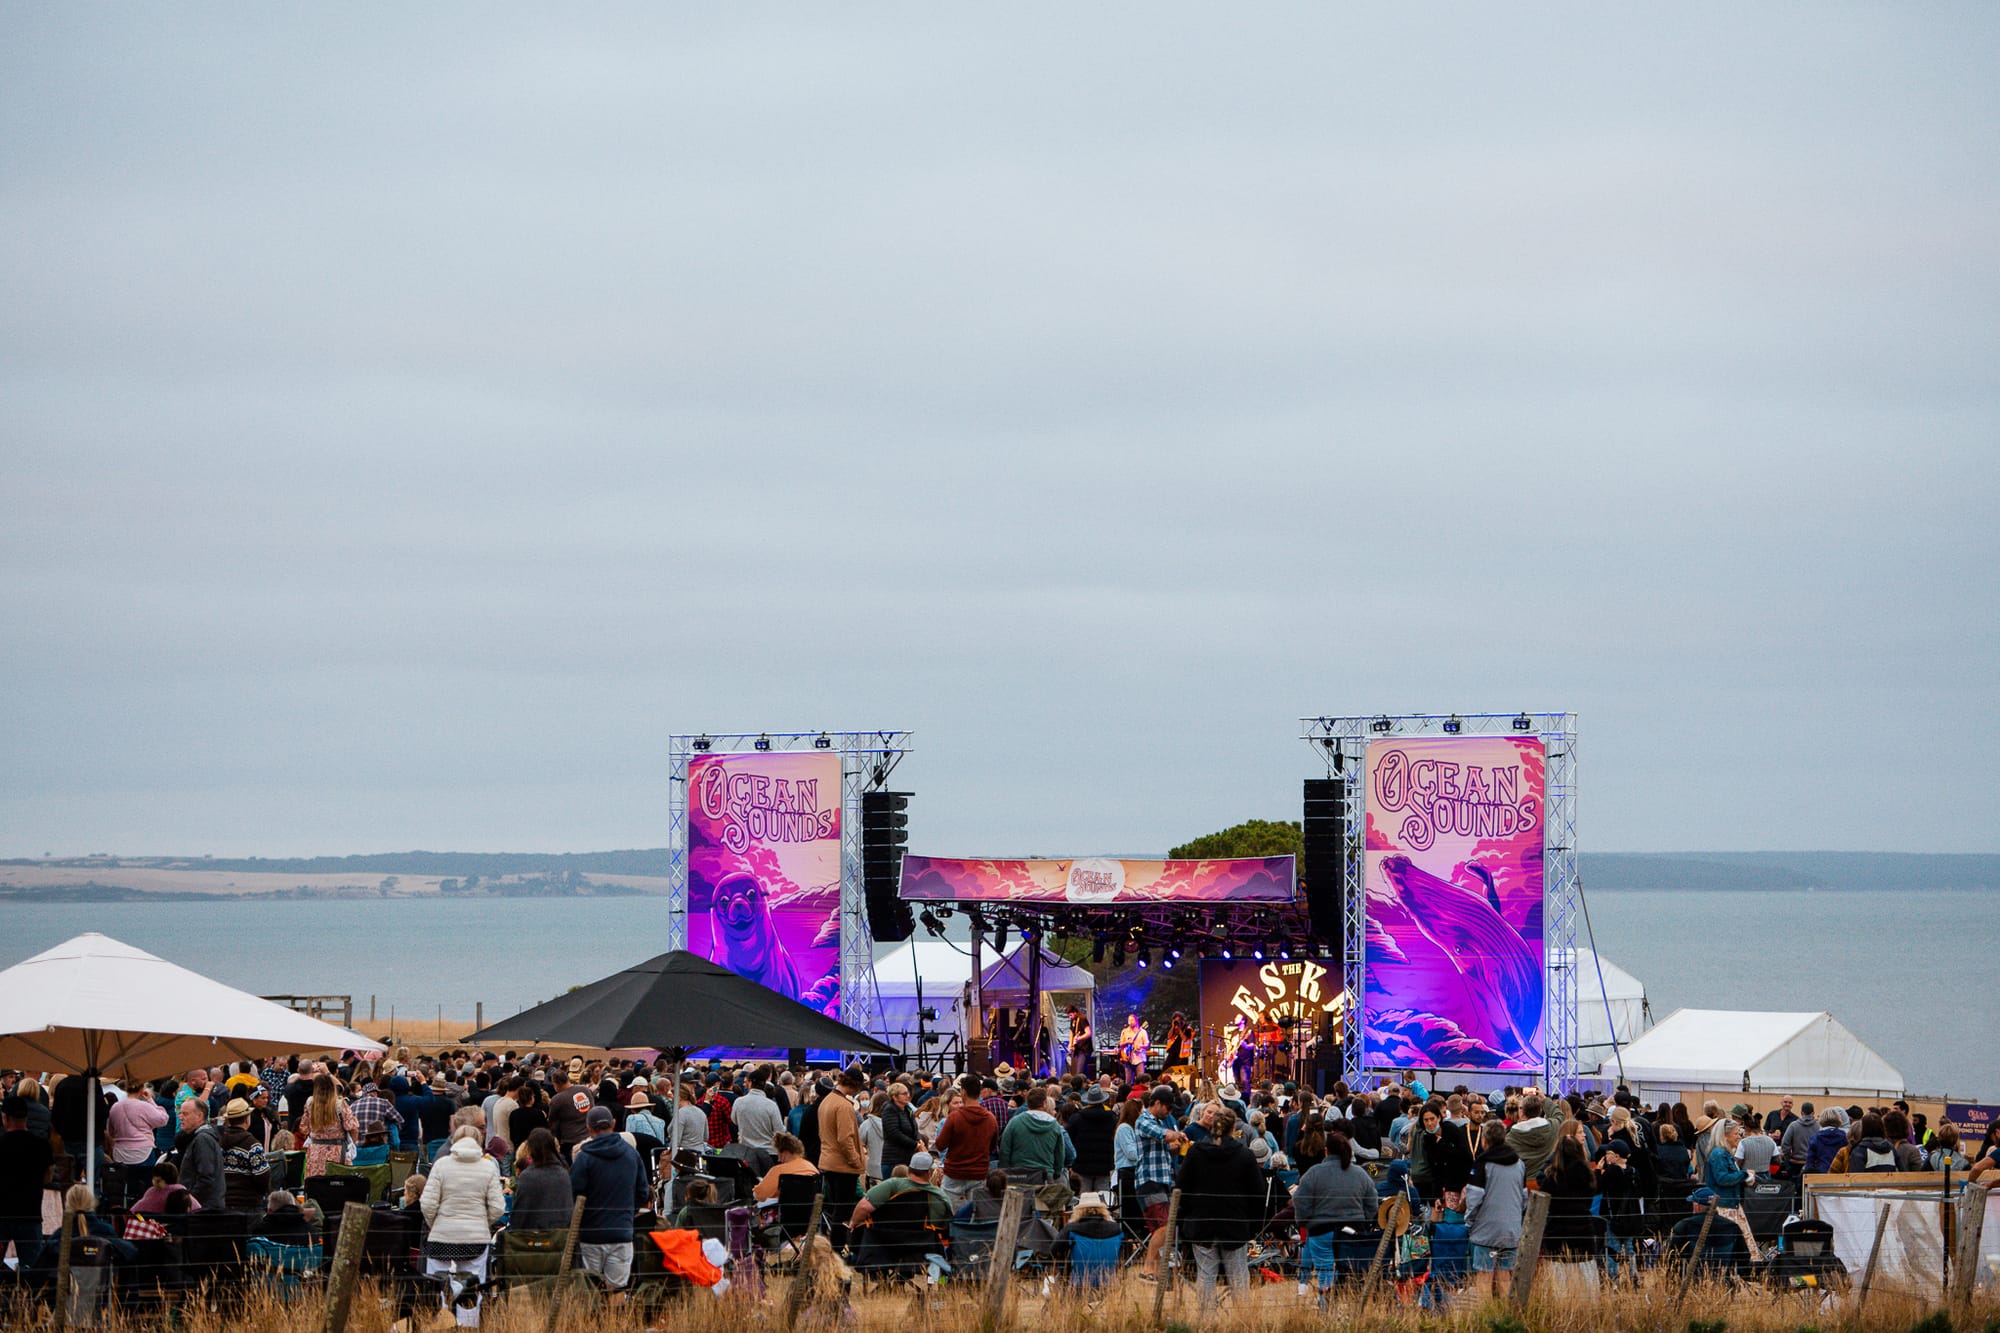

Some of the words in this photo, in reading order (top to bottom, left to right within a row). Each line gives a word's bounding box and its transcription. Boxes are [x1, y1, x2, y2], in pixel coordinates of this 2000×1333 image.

[699, 765, 817, 820] OCEAN
[1373, 750, 1519, 812] OCEAN
[720, 799, 832, 855] SOUNDS
[1398, 790, 1538, 851] SOUNDS
[1281, 962, 1302, 976] THE
